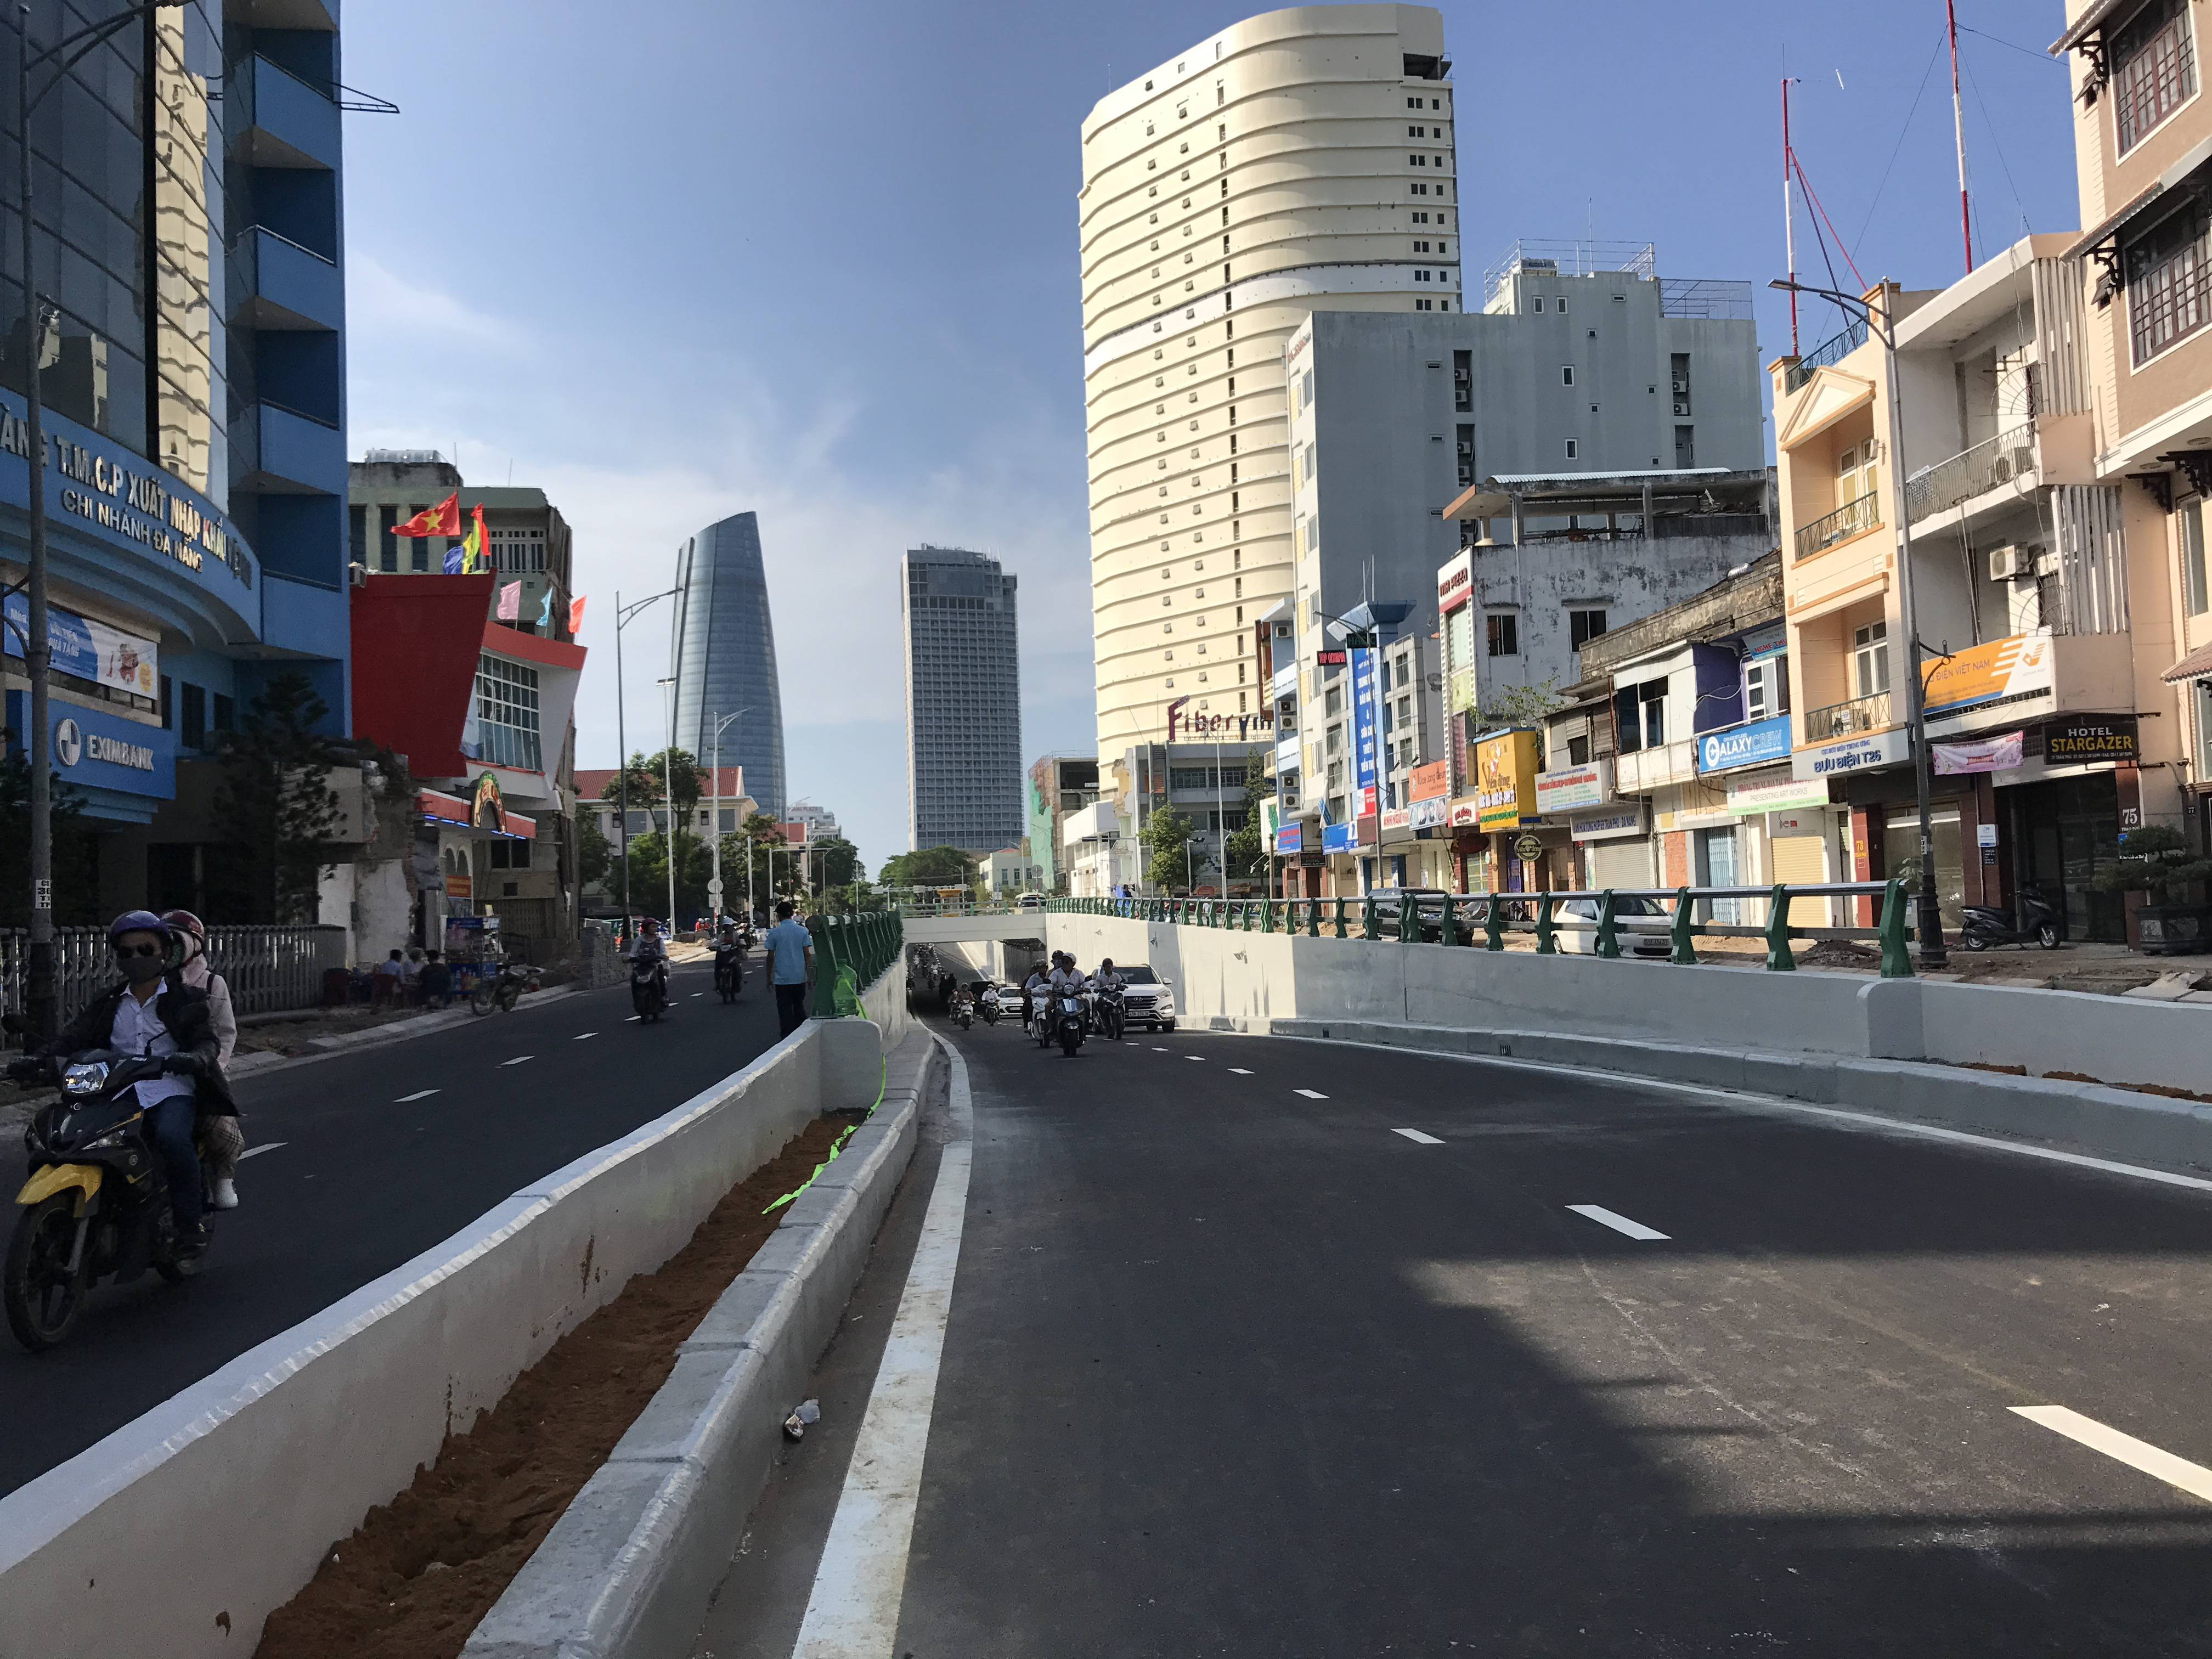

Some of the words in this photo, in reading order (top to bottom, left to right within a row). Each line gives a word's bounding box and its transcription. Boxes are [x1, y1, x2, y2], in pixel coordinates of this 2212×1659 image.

[127, 470, 167, 521] XUẤT
[168, 495, 201, 540] NHẬP
[61, 489, 93, 519] CHI
[98, 501, 150, 544] NHÁNH
[153, 528, 171, 556] ĐÀ
[1936, 667, 1954, 681] ĐIỆN
[1955, 661, 1972, 676] VIỆT
[1973, 658, 1990, 670] NAM
[2068, 727, 2113, 737] HOTEL
[86, 735, 154, 771] EXIMBANK
[2051, 736, 2132, 753] STARGAZER
[1836, 752, 1861, 769] ĐIỆN
[1861, 749, 1882, 764] T26
[1750, 792, 1779, 802] PRESENTING
[1789, 787, 1808, 797] WORKS
[2123, 808, 2137, 825] 75
[1856, 840, 1864, 851] 73
